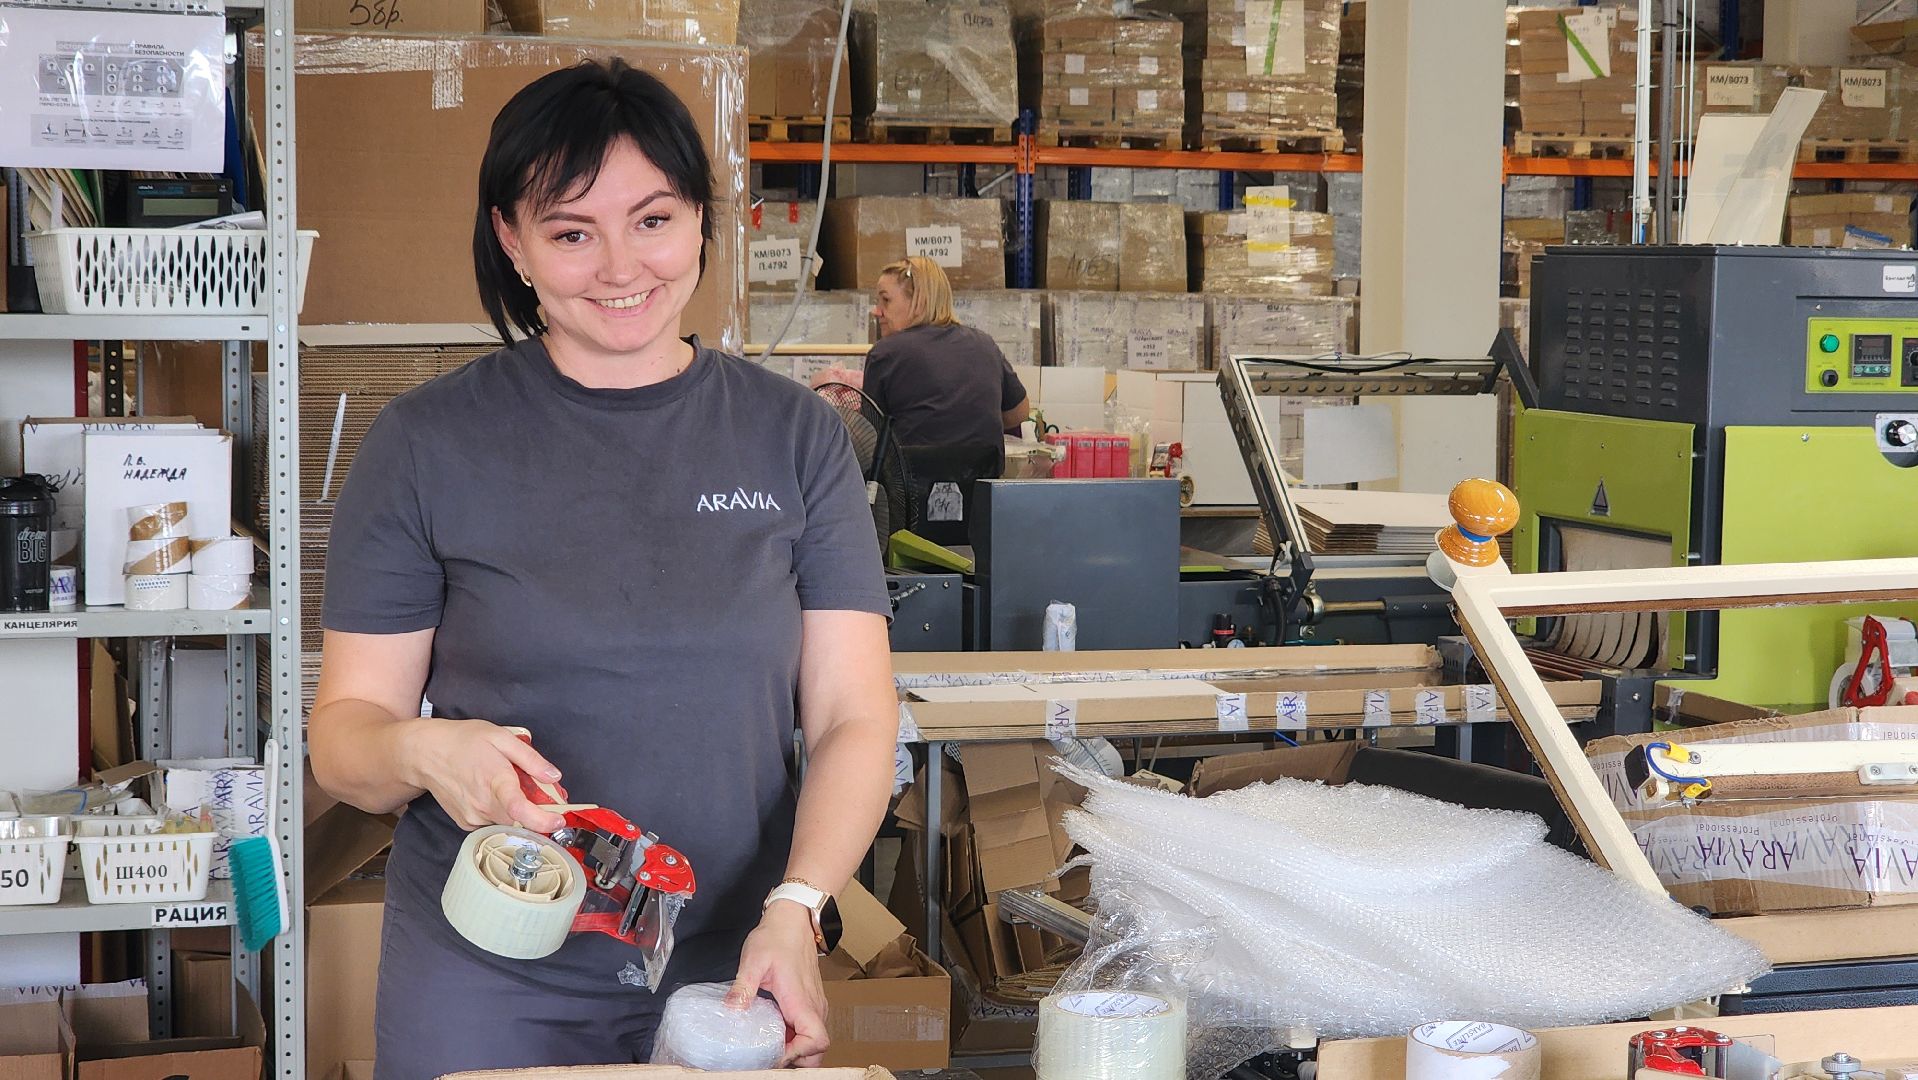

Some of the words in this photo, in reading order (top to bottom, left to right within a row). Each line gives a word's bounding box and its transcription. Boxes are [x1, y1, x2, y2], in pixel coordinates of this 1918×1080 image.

[123, 467, 187, 482] НАДЕЖДА
[696, 486, 781, 512] ARAVIA
[17, 538, 47, 564] BIG
[4, 619, 78, 630] КАНЦЕЛЯРИЯ
[1696, 824, 1760, 836] Professional
[1697, 836, 1798, 873] ARAVIA
[116, 864, 168, 881] Ш400
[155, 906, 227, 924] РАЦИЯ
